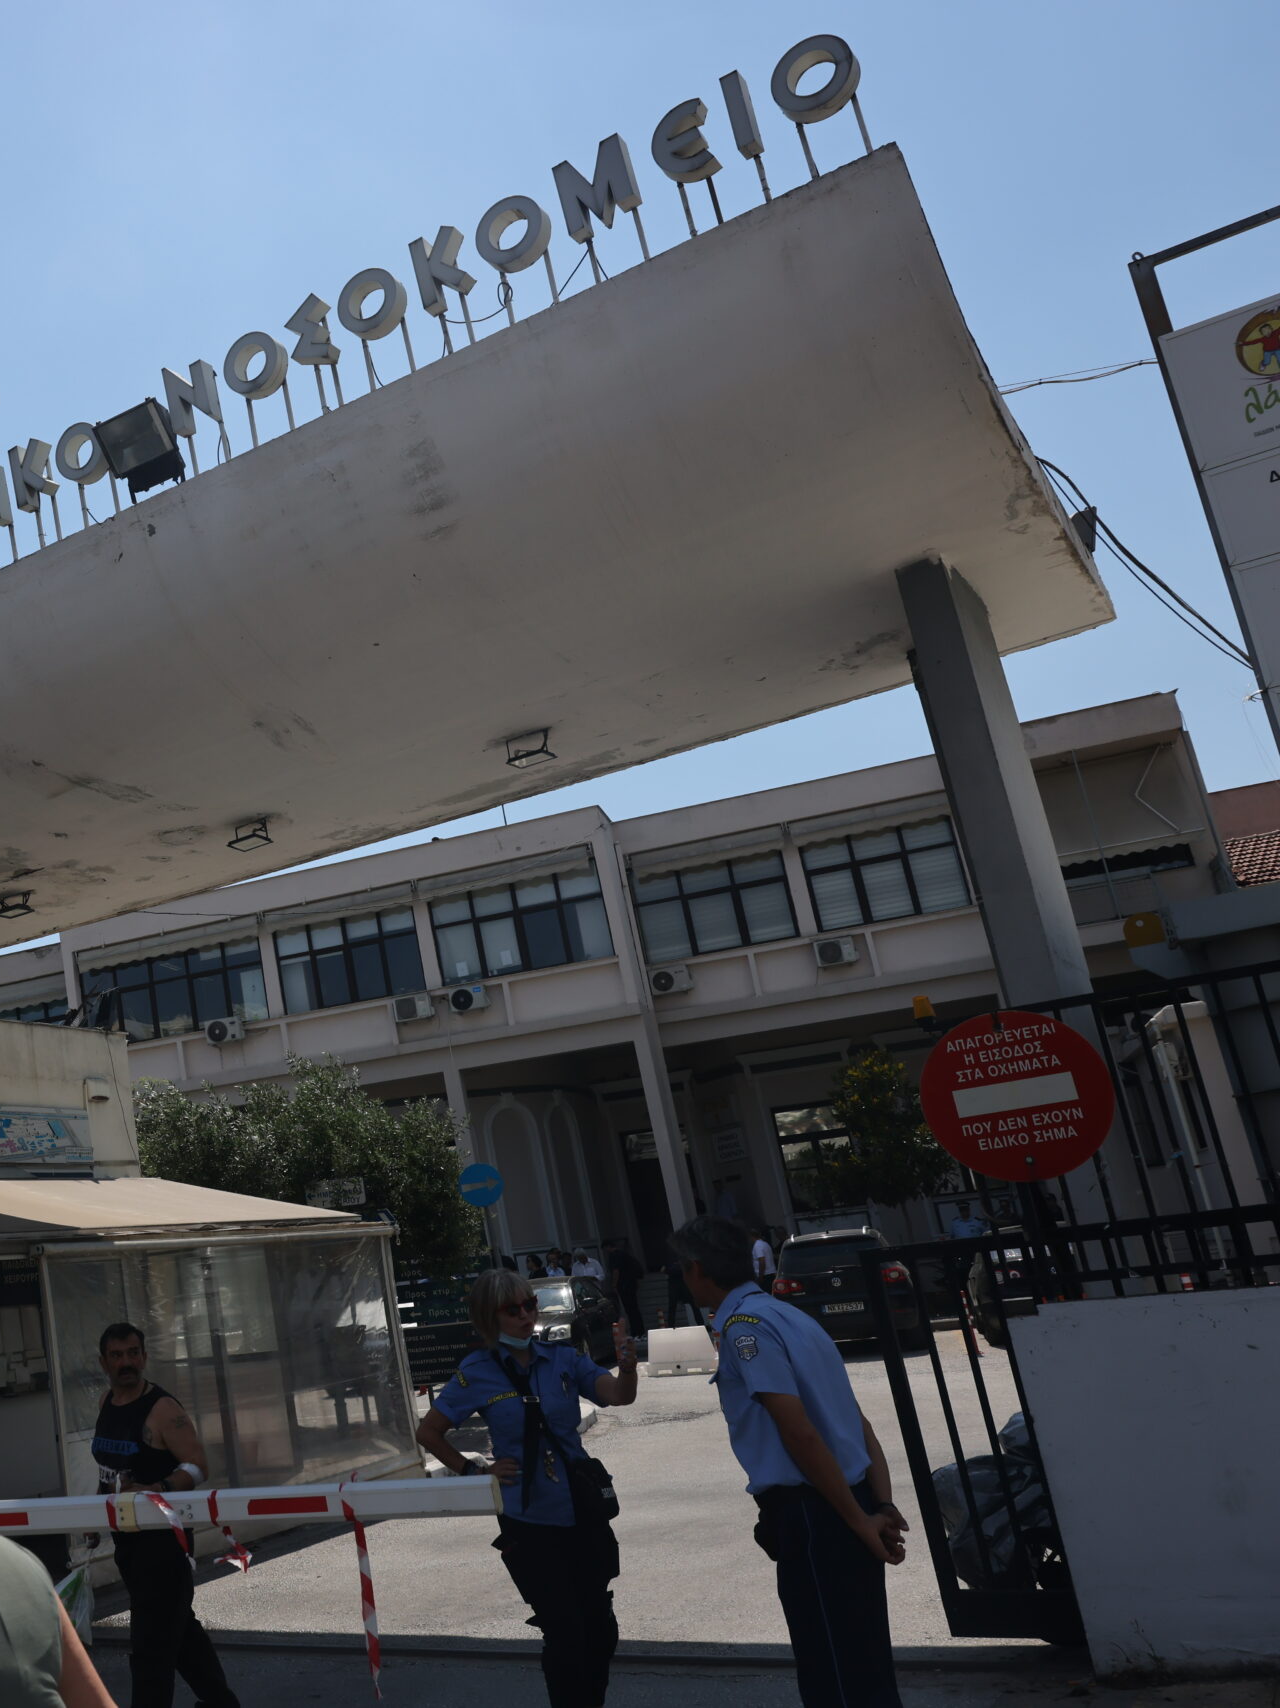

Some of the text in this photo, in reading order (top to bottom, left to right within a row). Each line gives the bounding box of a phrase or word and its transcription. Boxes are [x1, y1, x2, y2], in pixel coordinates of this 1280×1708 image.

[161, 34, 860, 439] ΝΟΣΟΚΟΜΕΙΟ
[946, 1022, 1056, 1054] ΑΠΑΓΟΡΕΥΕΤΑΙ
[964, 1041, 1044, 1066] Η ΕΙΣΟΔΟΣ
[956, 1054, 1062, 1084] ΣΤΑ ΟΧΗΜΑΤΑ
[962, 1107, 1084, 1137] ΠΟΥ ΔΕΝ ΕΧΟΥΝ
[978, 1125, 1078, 1151] ΕΙΔΙΚΟ ΣΗΜΑ
[428, 1308, 450, 1318] Προς
